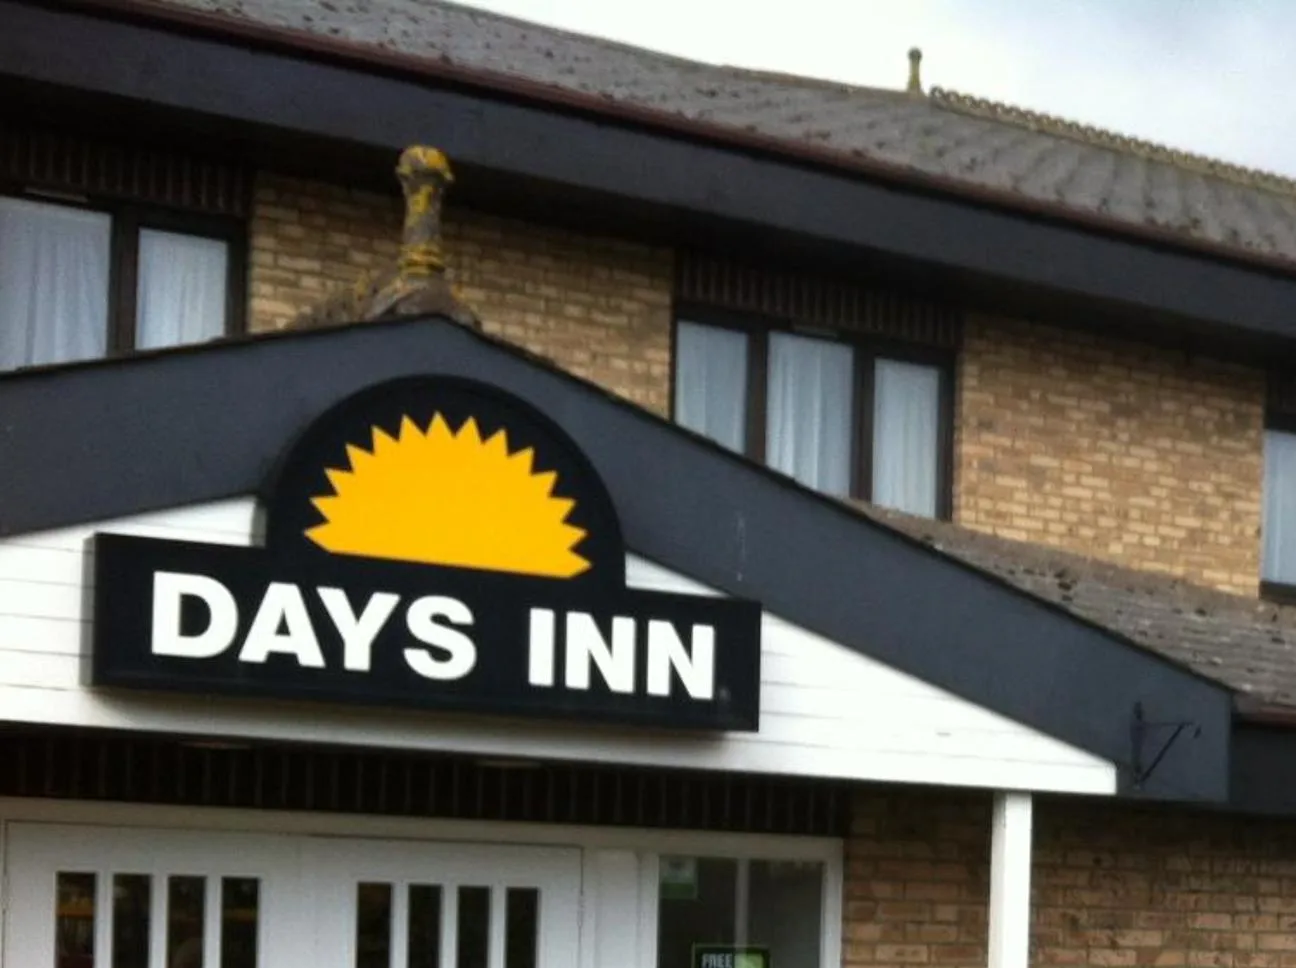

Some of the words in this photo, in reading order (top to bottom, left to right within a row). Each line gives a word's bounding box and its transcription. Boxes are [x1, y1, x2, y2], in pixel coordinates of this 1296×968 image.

[150, 570, 476, 681] DAYS
[527, 606, 715, 700] INN
[701, 953, 733, 968] FREE
